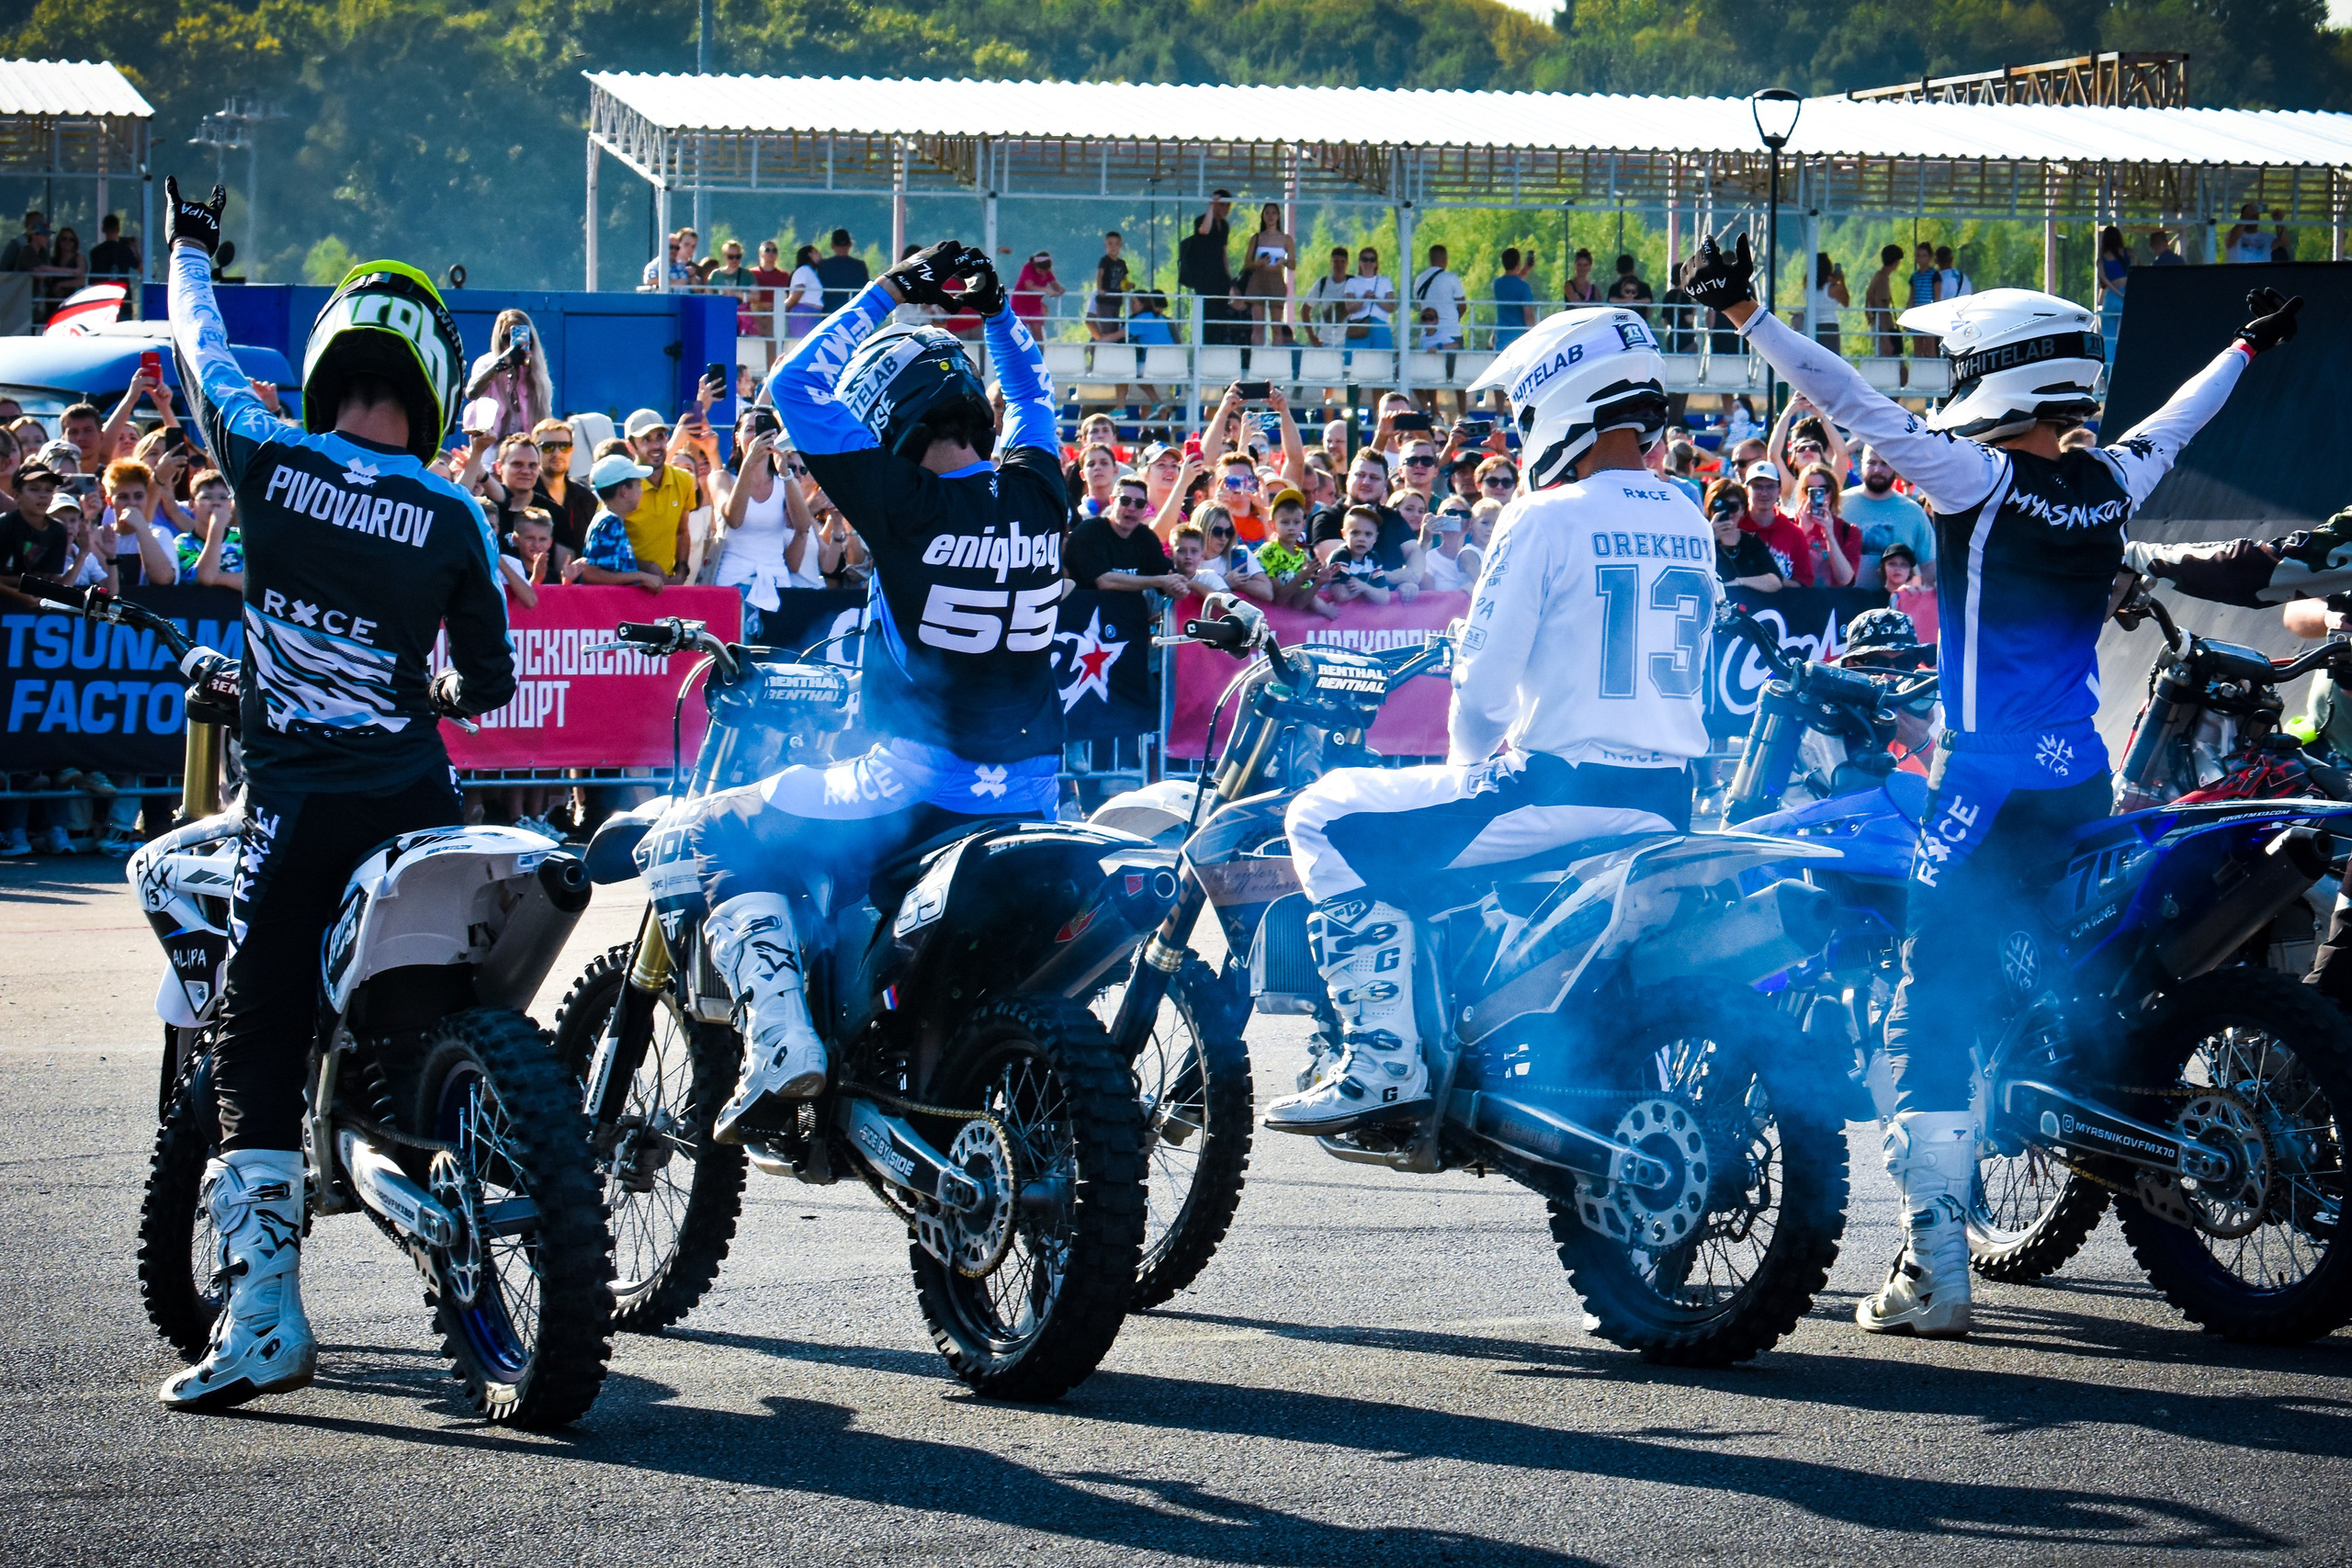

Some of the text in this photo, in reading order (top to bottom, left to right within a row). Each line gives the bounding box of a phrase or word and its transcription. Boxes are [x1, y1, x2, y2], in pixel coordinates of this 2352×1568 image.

[181, 202, 219, 230] ALIPA
[1685, 276, 1726, 297] ALIPA
[1955, 337, 2056, 381] WHITELAB
[265, 464, 435, 548] PIVOVAROV
[918, 579, 1063, 654] 55
[1593, 563, 1715, 701] 13
[1316, 676, 1386, 694] RENTHAL
[1317, 663, 1388, 682] RENTHAL
[173, 947, 207, 970] ALIPA
[1374, 946, 1400, 973] G
[1383, 1086, 1398, 1102] G
[876, 1139, 890, 1159] BY
[888, 1151, 916, 1177] SIDE
